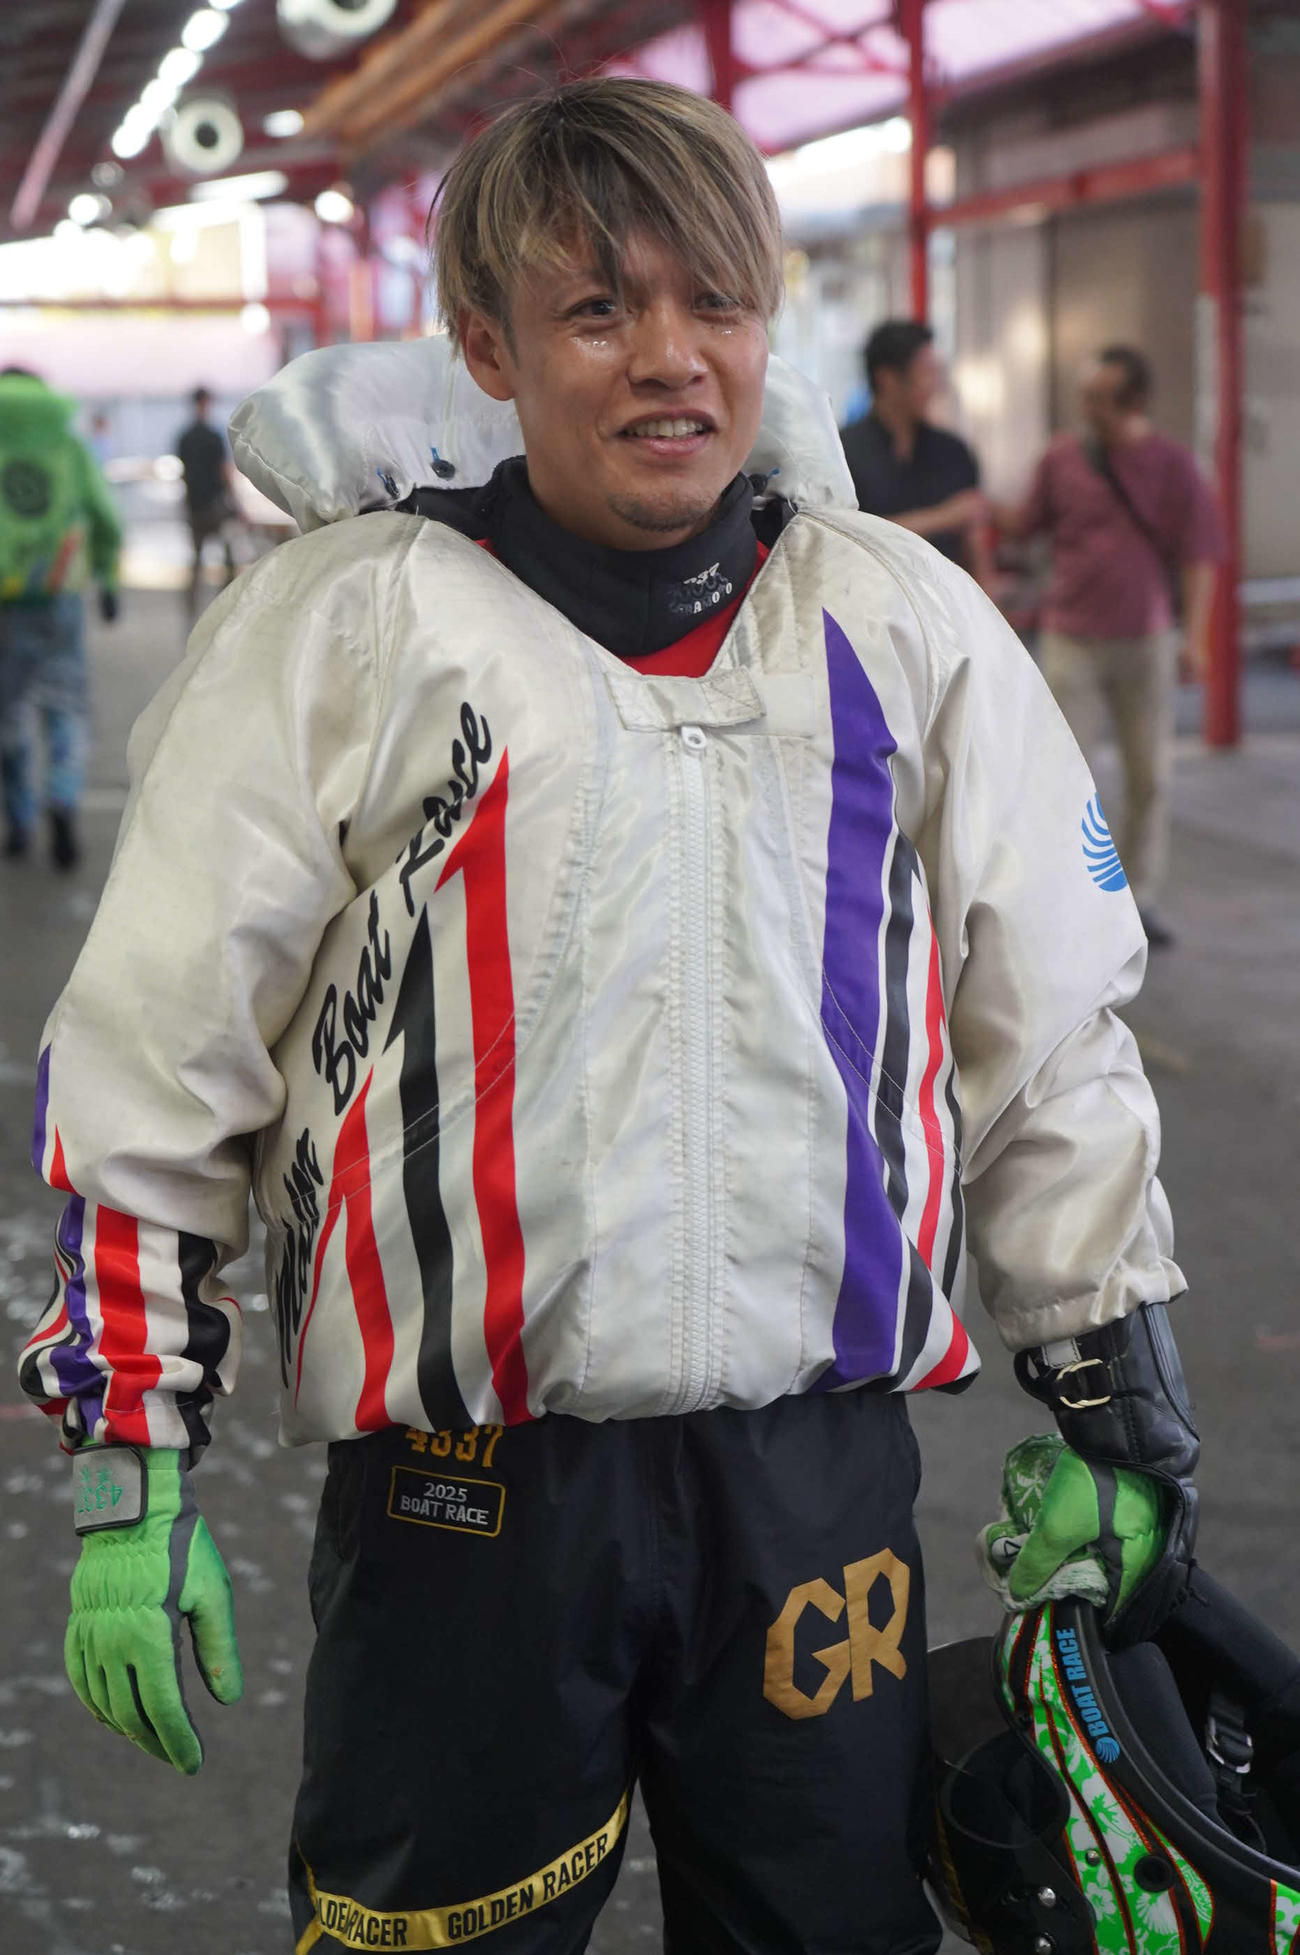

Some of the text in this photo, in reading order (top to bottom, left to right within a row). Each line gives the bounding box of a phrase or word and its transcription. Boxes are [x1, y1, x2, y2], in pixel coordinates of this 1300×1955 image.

[312, 889, 392, 1116] Boat
[396, 702, 492, 918] Race
[400, 1495, 489, 1525] BOAT RACE
[424, 1482, 468, 1503] 2025
[762, 1547, 911, 1721] GR
[1056, 1627, 1110, 1737] BOAT RACE
[447, 1833, 608, 1941] GOLDEN RACER
